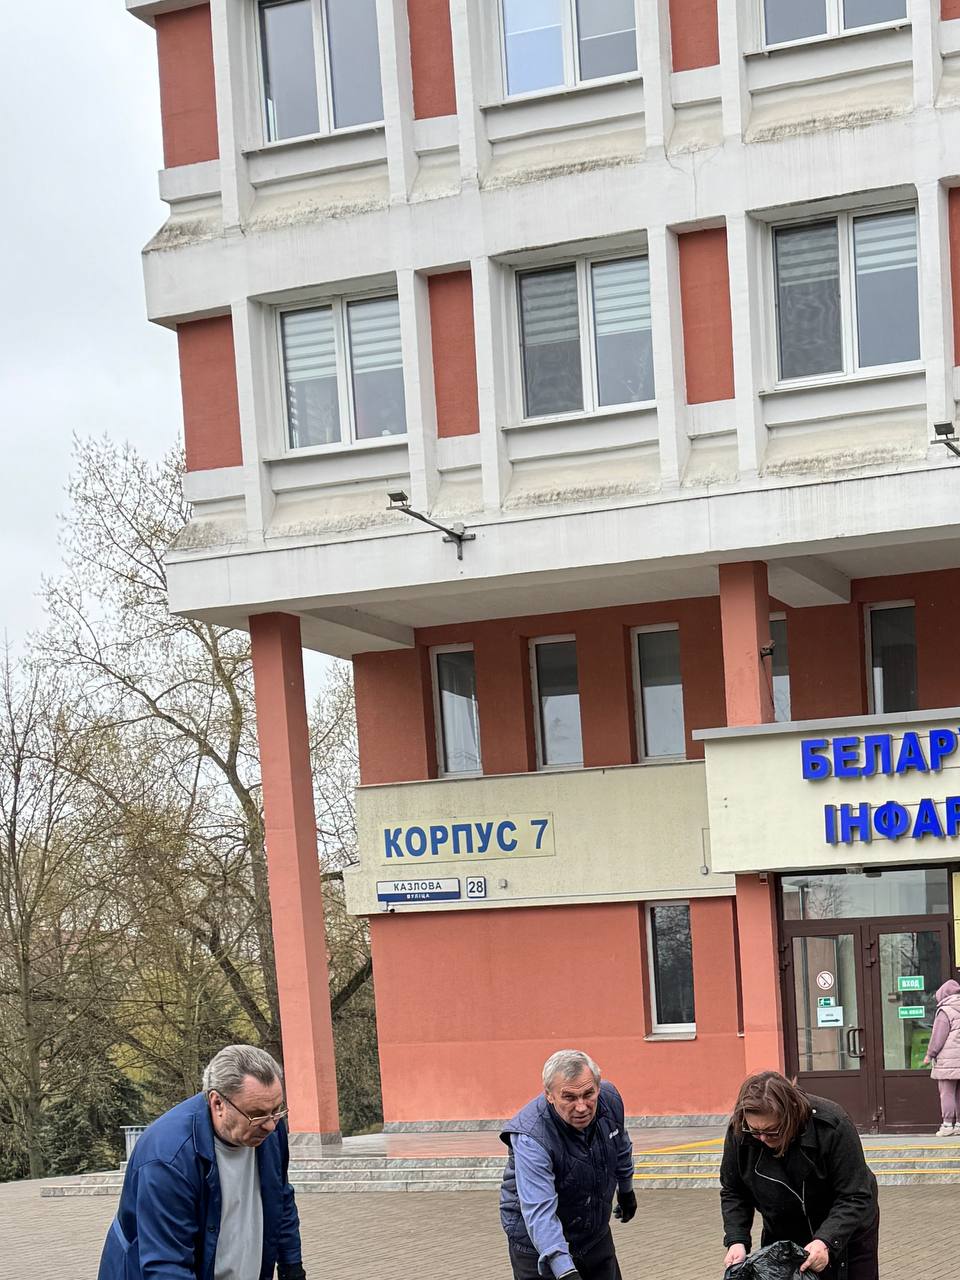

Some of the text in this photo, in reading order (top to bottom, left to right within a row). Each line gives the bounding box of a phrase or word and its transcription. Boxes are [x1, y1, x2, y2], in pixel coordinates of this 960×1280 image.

[383, 819, 549, 859] КОРПУС 7
[393, 881, 443, 891] КАЗЛОВА
[468, 880, 484, 894] 28
[901, 979, 920, 988] ВХОД
